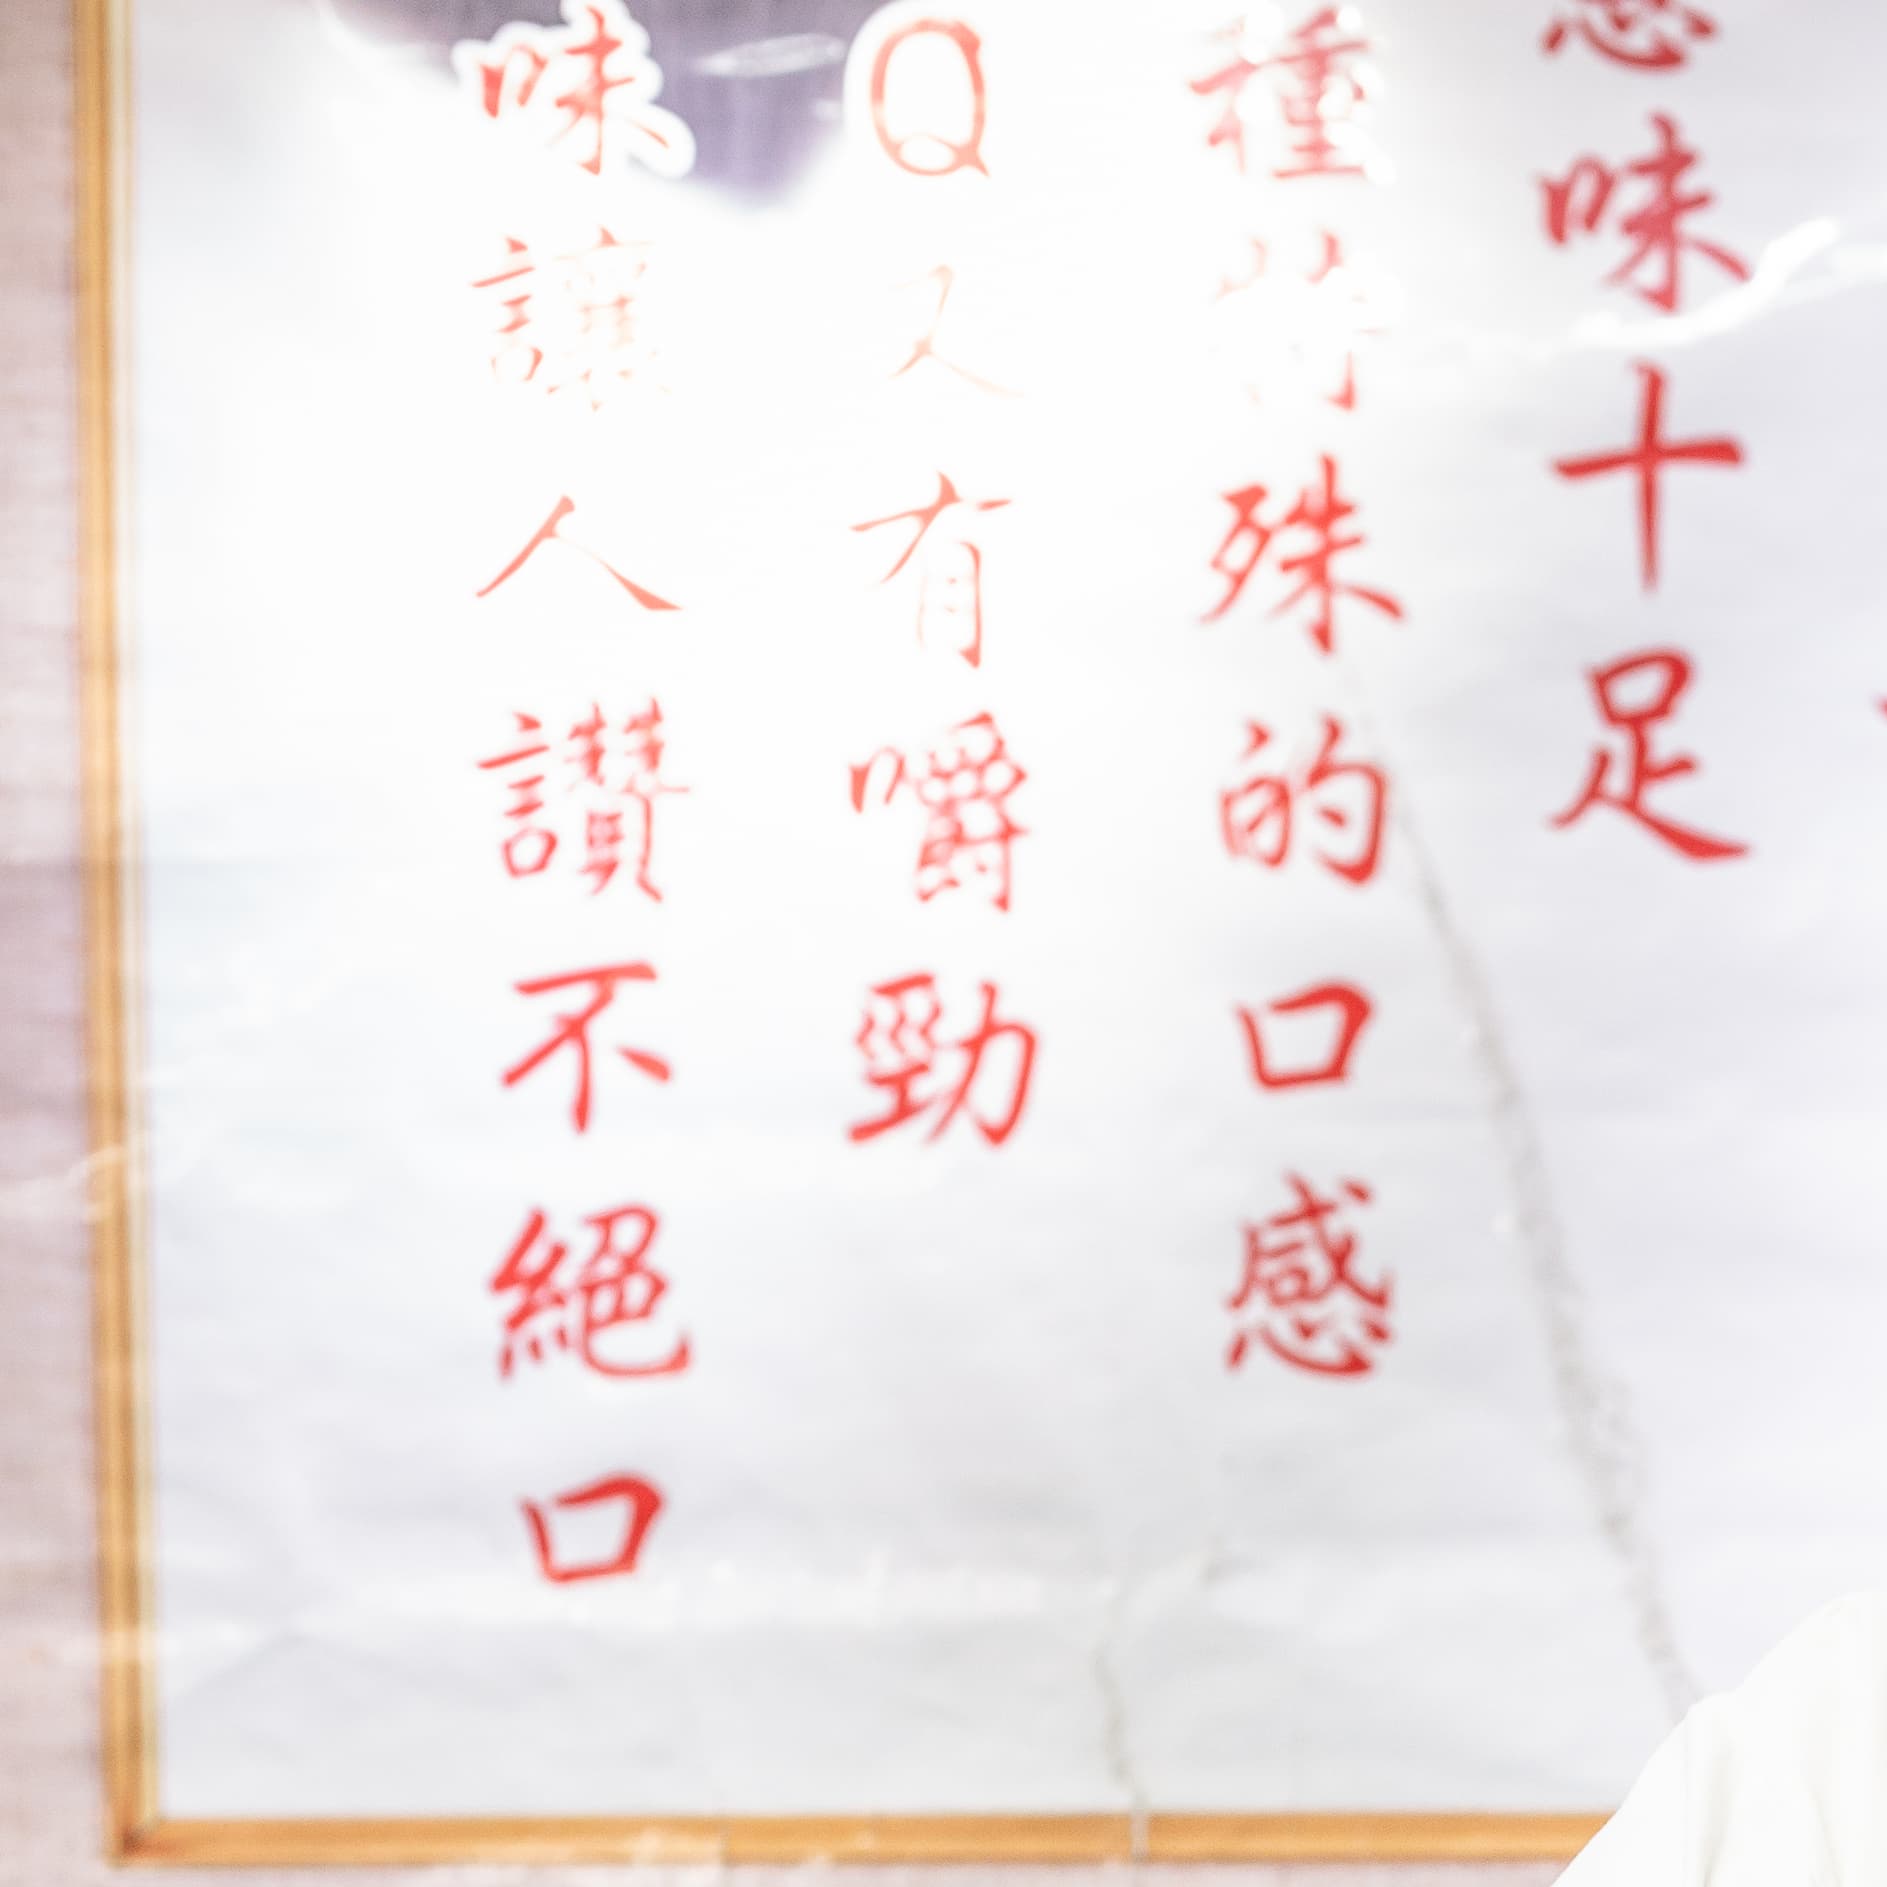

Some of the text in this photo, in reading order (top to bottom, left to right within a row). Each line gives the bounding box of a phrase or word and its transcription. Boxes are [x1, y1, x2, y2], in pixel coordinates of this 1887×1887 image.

[476, 6, 692, 1586] 味讓人讚不絕口
